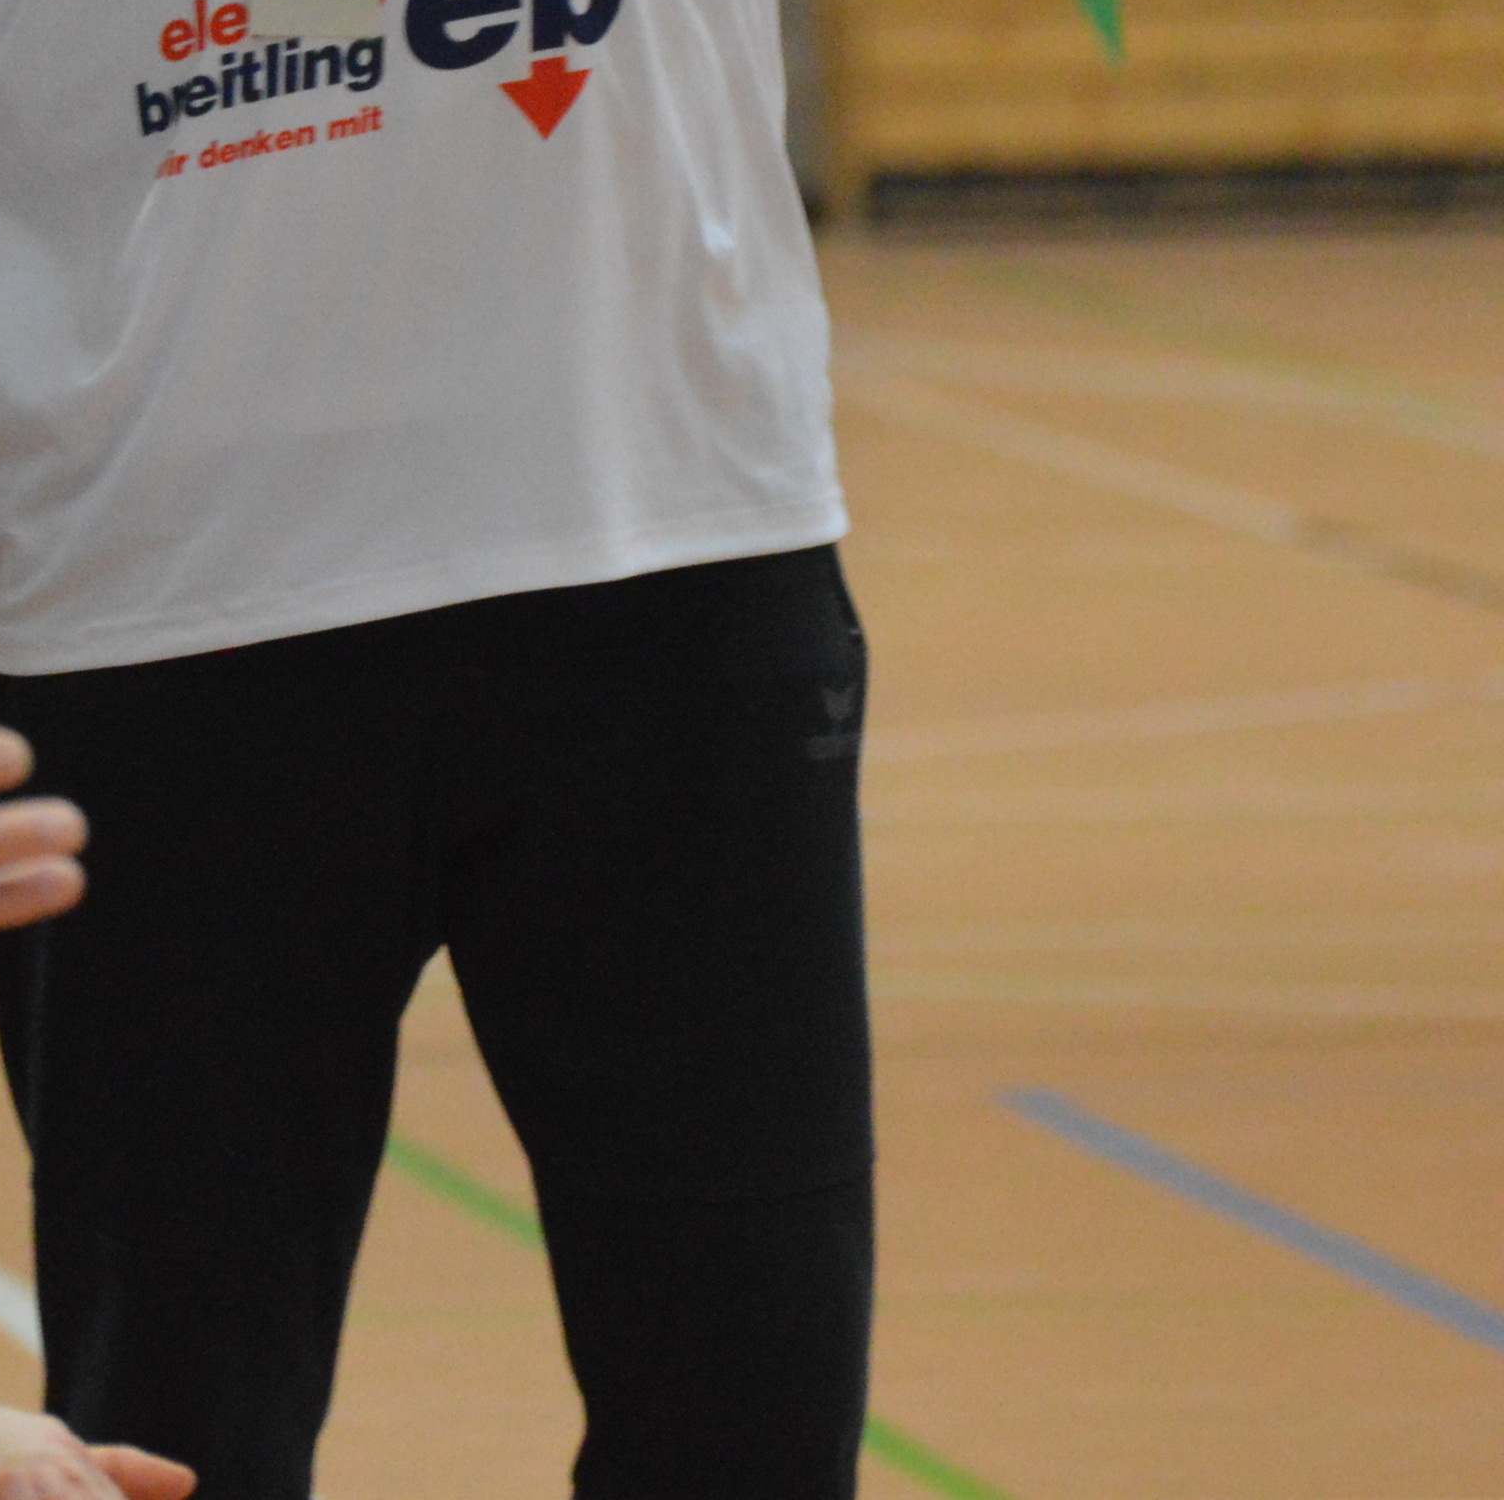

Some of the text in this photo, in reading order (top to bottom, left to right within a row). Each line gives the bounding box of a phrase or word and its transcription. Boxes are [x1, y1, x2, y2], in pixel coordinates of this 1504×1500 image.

[137, 35, 385, 137] breitling
[198, 125, 318, 170] denken
[327, 104, 384, 141] mit
